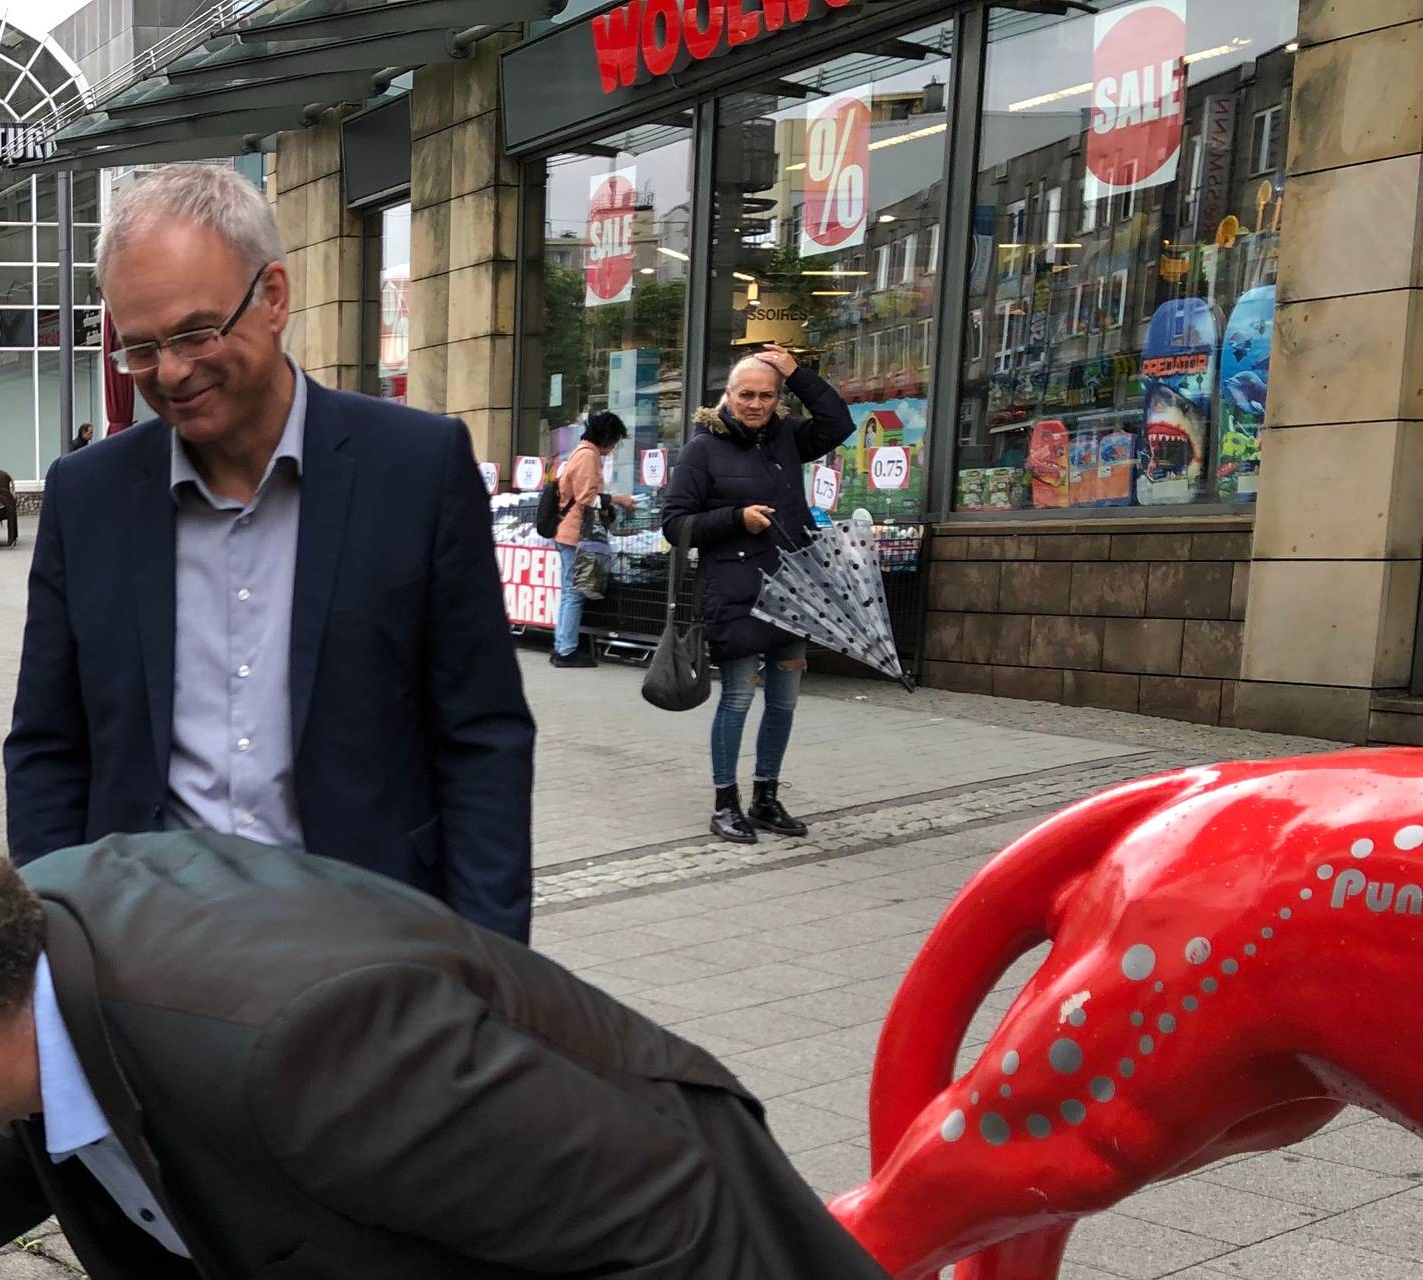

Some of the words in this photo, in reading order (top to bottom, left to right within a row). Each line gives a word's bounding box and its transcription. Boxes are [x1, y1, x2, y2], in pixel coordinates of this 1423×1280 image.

[593, 0, 850, 93] WOOL
[1093, 57, 1185, 135] SALE
[809, 108, 864, 234] %
[590, 214, 634, 261] SALE
[816, 478, 835, 499] 1.75
[874, 460, 904, 478] 0.75
[1330, 868, 1423, 915] Pun
